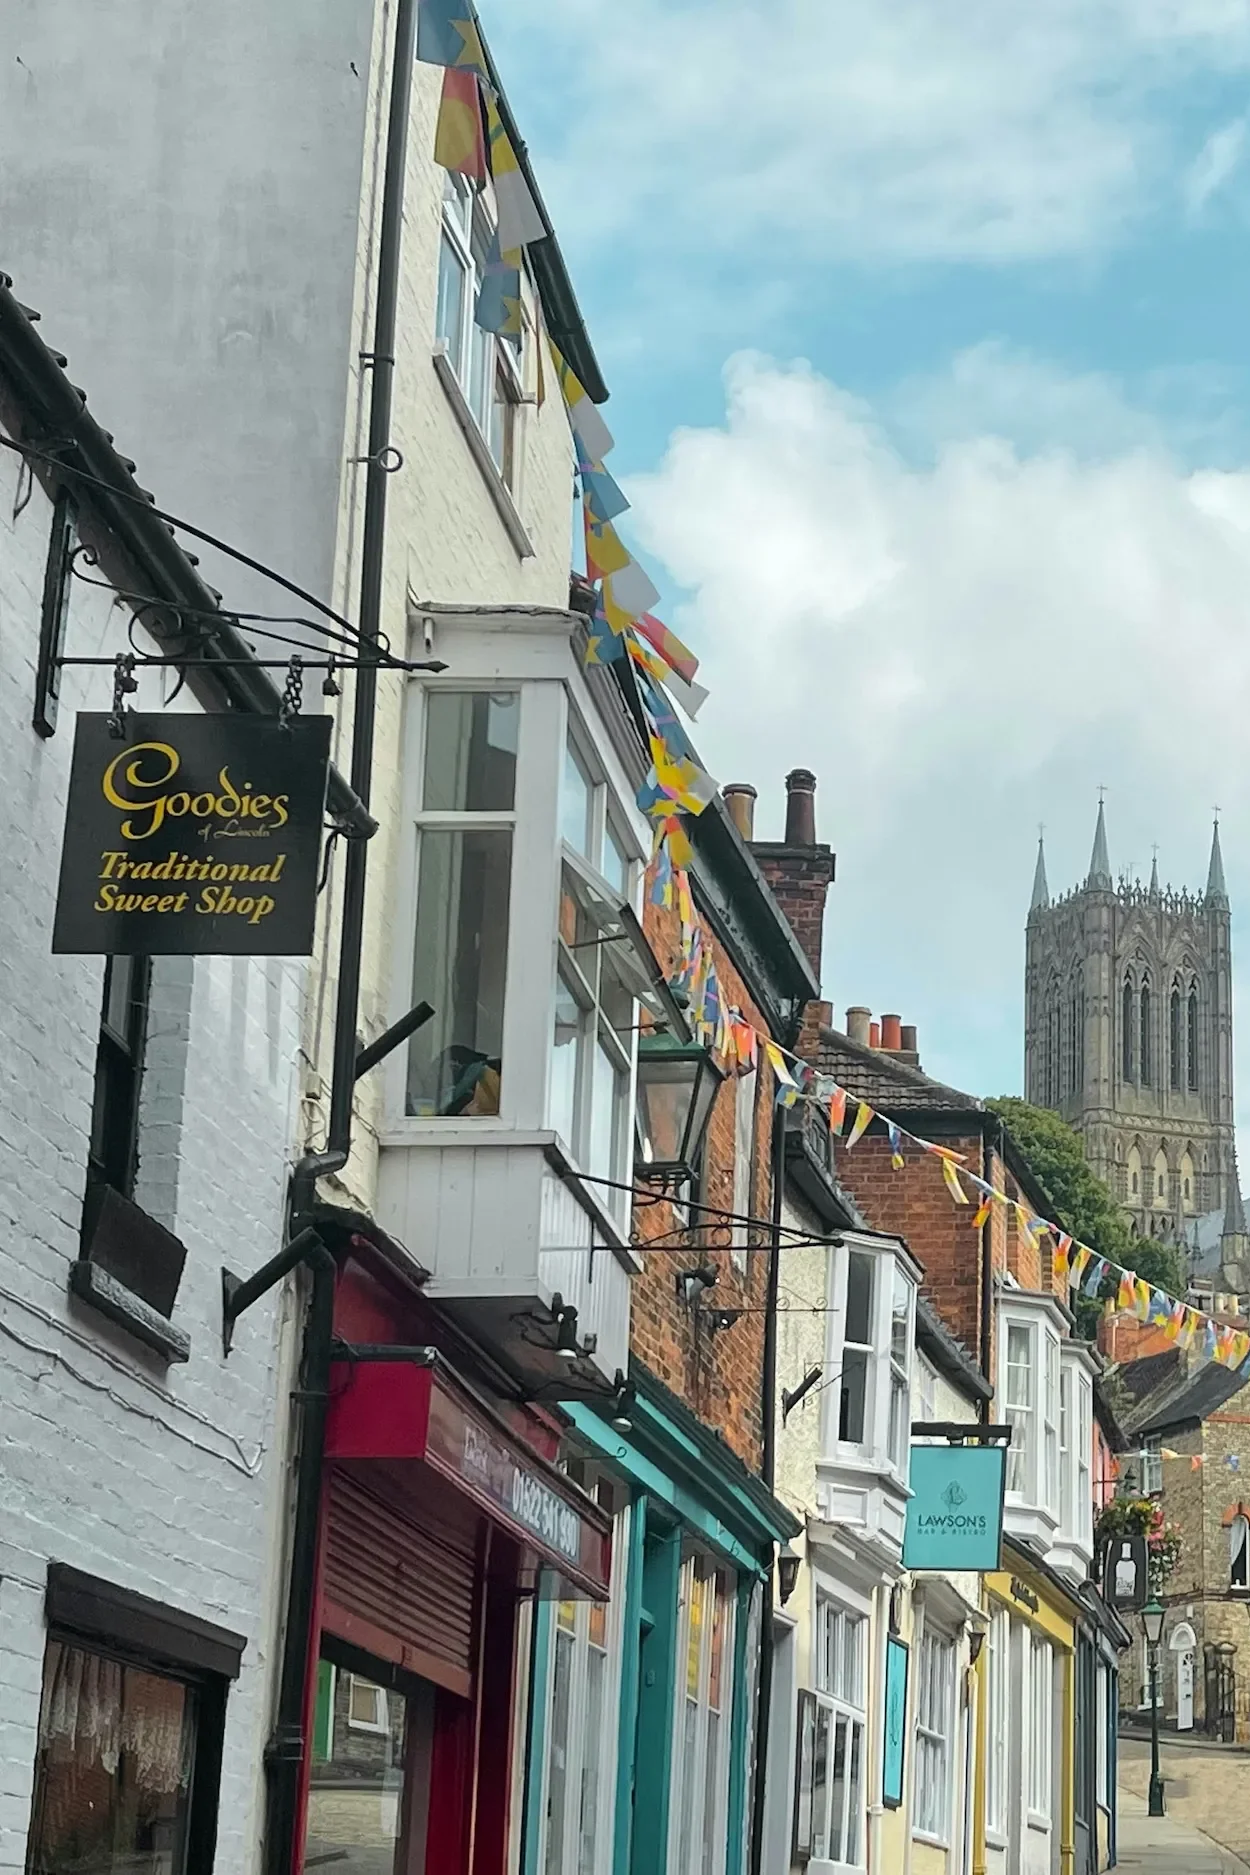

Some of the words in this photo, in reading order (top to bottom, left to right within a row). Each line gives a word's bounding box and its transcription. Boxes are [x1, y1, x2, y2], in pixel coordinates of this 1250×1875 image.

[103, 742, 289, 840] Goodies
[198, 823, 212, 843] of
[98, 851, 286, 882] Traditional
[94, 884, 189, 912] Sweet
[195, 886, 275, 924] Shop
[918, 1514, 986, 1527] LAWSON'S
